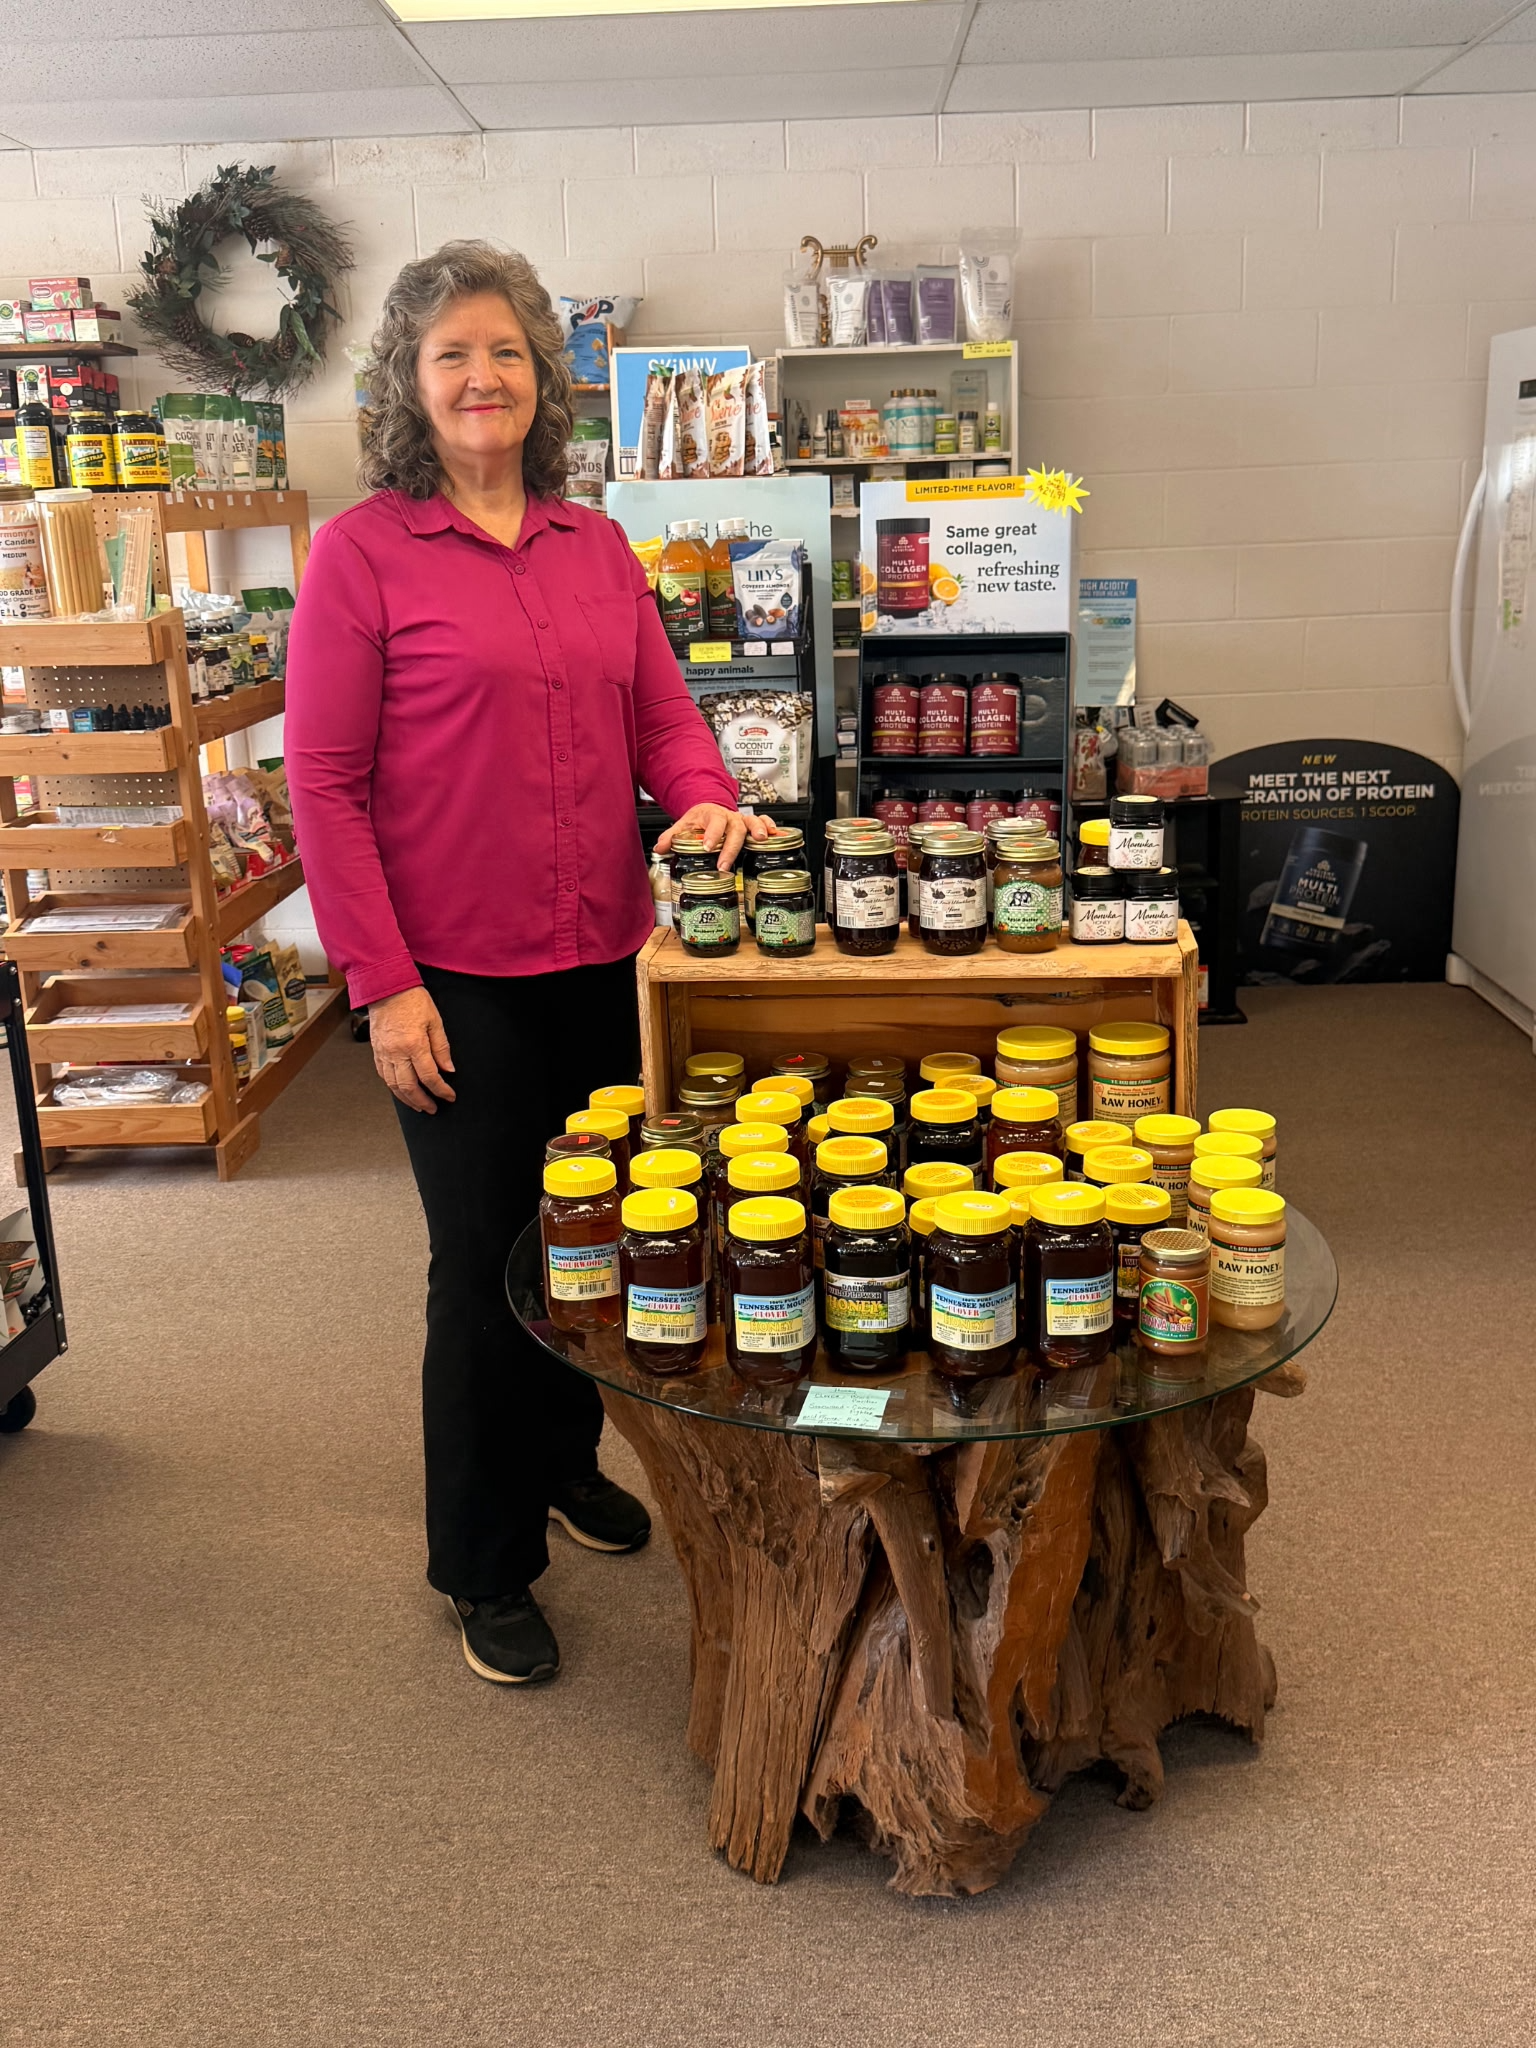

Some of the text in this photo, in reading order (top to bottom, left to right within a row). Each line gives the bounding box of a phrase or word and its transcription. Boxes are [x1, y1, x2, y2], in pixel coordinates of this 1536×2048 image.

[915, 483, 1016, 495] LIMITED-TIME FLAVOR!
[946, 522, 1037, 539] Same great
[5, 538, 35, 547] Candles
[946, 542, 1017, 557] collagen,
[880, 565, 927, 574] COLLAGEN
[977, 561, 1060, 578] refreshing
[977, 579, 1056, 593] new taste.
[1080, 581, 1128, 590] HIGH ACIDITY
[10, 589, 33, 597] GRADE
[686, 665, 754, 676] happy animals
[874, 715, 916, 724] COLLAGEN
[919, 715, 959, 724] COLLAGEN
[971, 714, 1011, 724] COLLAGEN
[735, 742, 774, 750] COCONUT
[1302, 754, 1337, 765] NEW
[1249, 769, 1391, 788] MEET THE NEXT
[1243, 784, 1434, 805] ERATION OF PROTEIN
[1241, 808, 1289, 822] ROTEIN
[1293, 806, 1356, 820] SOURCES.
[1369, 804, 1417, 817] SCOOP.
[1115, 837, 1160, 850] Manuka
[1297, 877, 1338, 895] MULTI
[1288, 886, 1341, 905] PROTEIN
[1079, 909, 1122, 922] Manuka
[1131, 909, 1175, 922] Manuka
[1101, 1096, 1161, 1108] RAW HONEY
[1168, 1181, 1188, 1190] HON
[552, 1253, 593, 1261] TENNESSEE
[557, 1260, 603, 1268] SOURWOOD
[1218, 1259, 1280, 1274] RAW HONEY
[560, 1271, 601, 1282] HONEY
[1052, 1285, 1099, 1294] TENNESSEE
[632, 1293, 679, 1303] TENNESSEE
[935, 1293, 1013, 1308] TENNESSEE MOUNTAIN
[1068, 1292, 1101, 1301] CLOVER
[738, 1303, 785, 1311] TENNESSEE
[830, 1295, 882, 1314] HONEY
[1063, 1302, 1105, 1315] HONEY
[948, 1305, 980, 1316] CLOVER
[642, 1311, 686, 1324] HONEY
[944, 1315, 985, 1330] HONEY
[750, 1320, 793, 1331] HONEY
